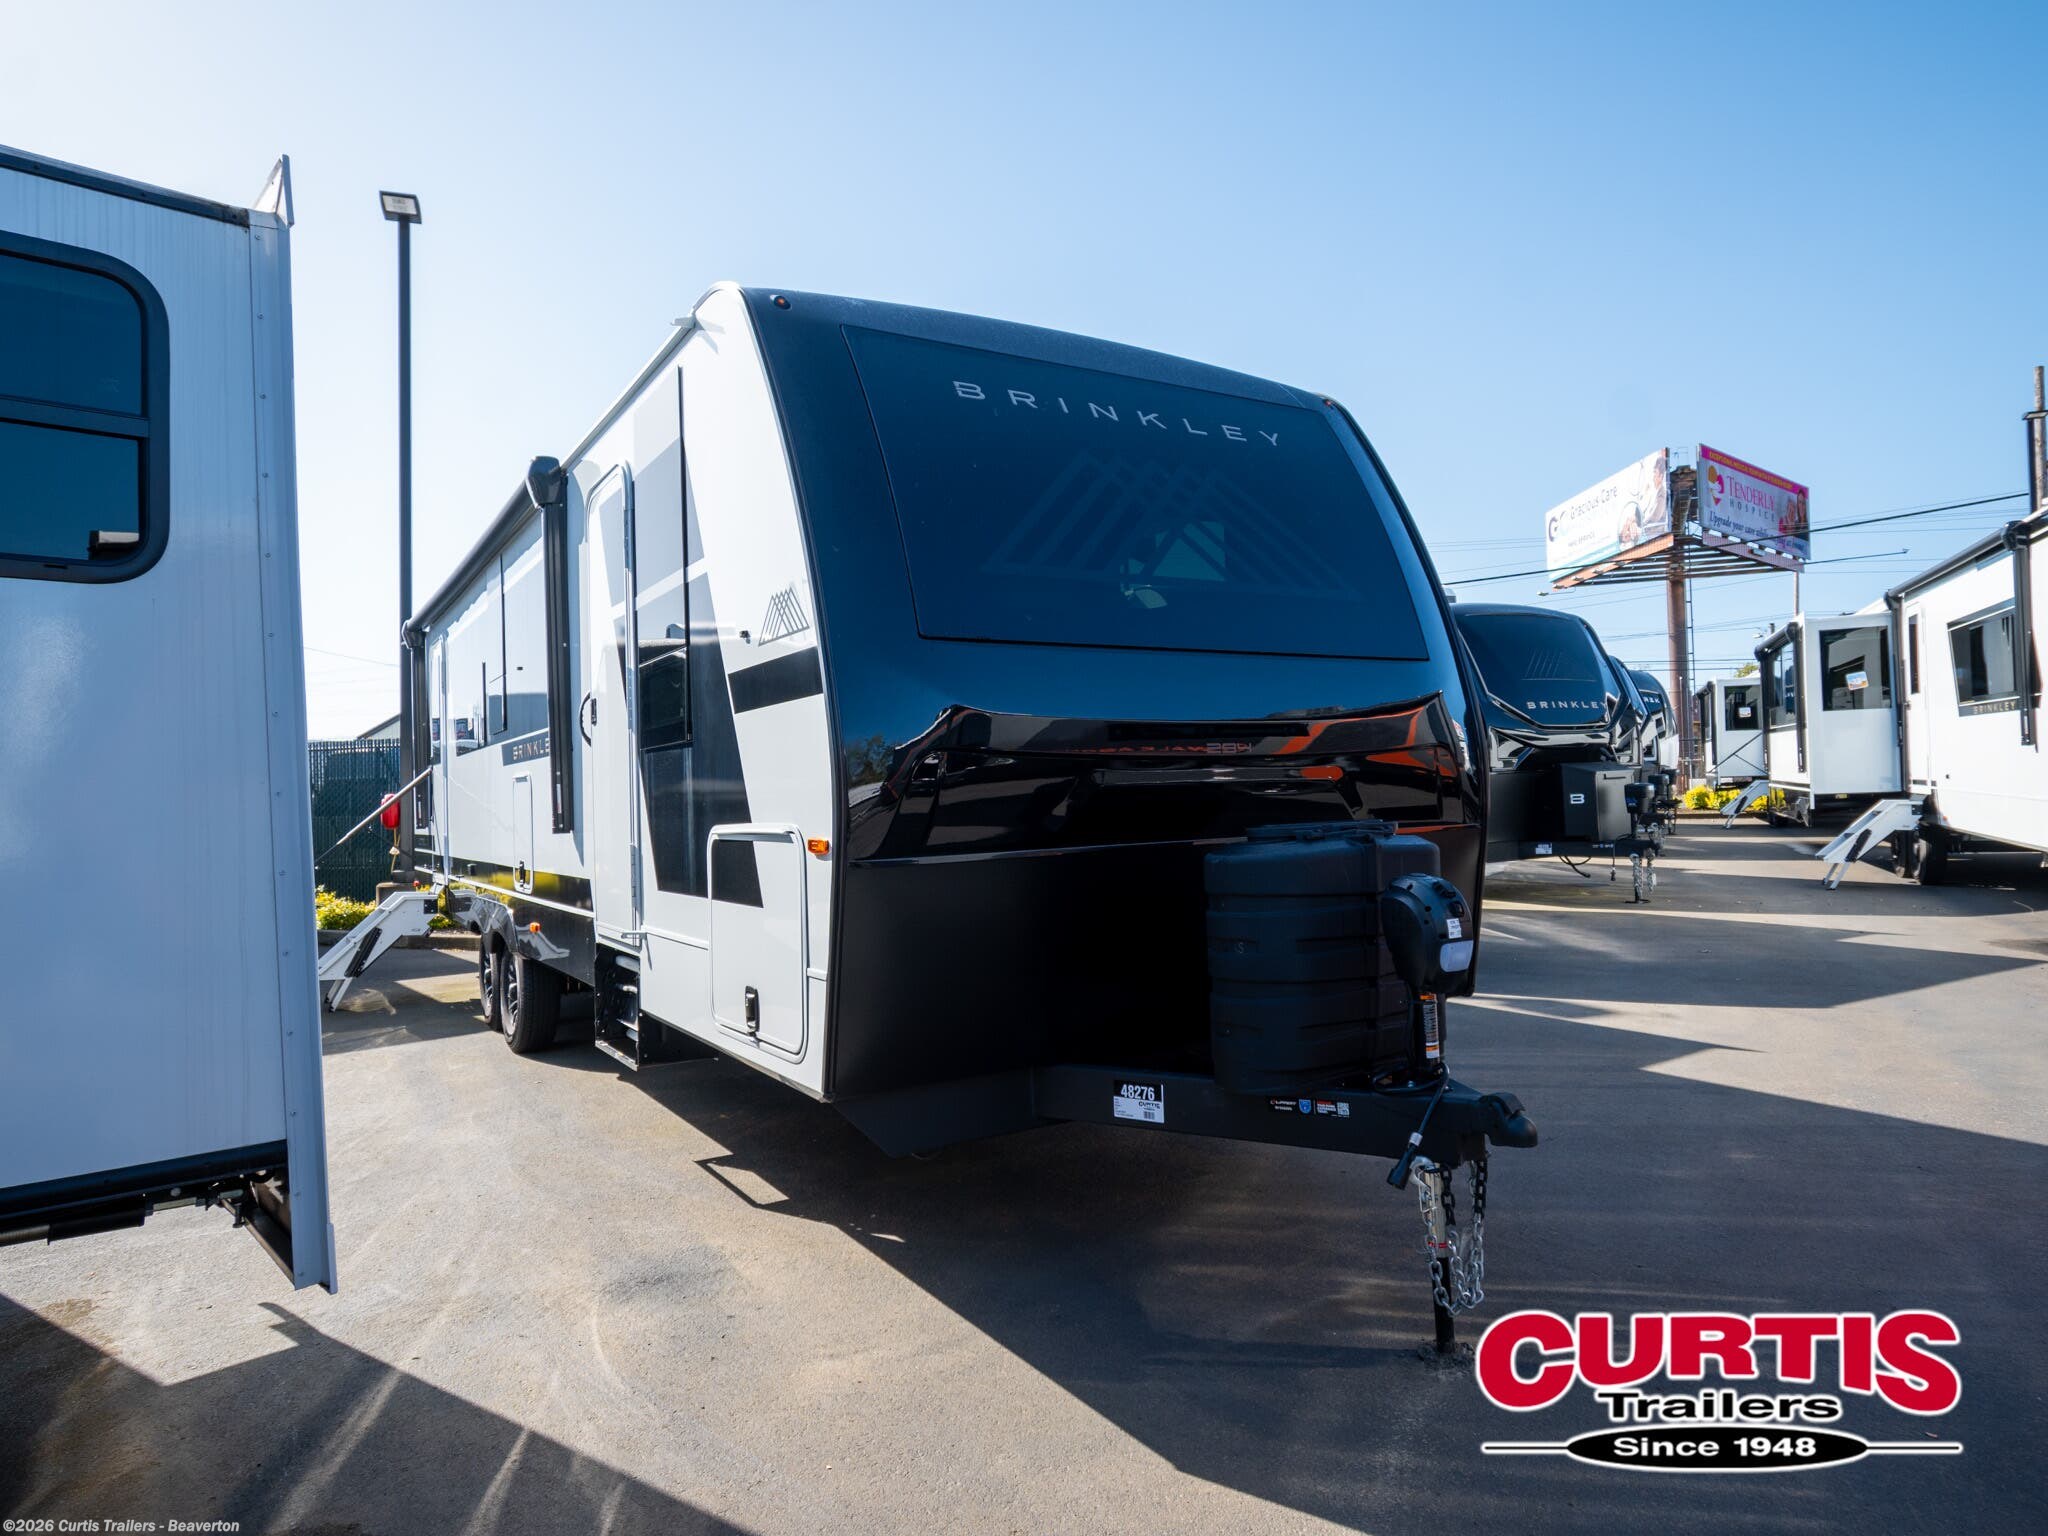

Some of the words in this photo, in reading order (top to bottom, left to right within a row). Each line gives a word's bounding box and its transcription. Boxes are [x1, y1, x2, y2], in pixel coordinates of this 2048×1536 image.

[952, 380, 1279, 447] BRINKLEY
[1726, 475, 1776, 512] TENDERLY
[1709, 510, 1732, 528] Upgrade
[1729, 498, 1776, 523] HOSPICE
[1526, 700, 1607, 710] BRINKLEY
[1972, 701, 2016, 715] BRINKLEY
[512, 738, 551, 760] BRINKLE
[1120, 1084, 1155, 1101] 48276
